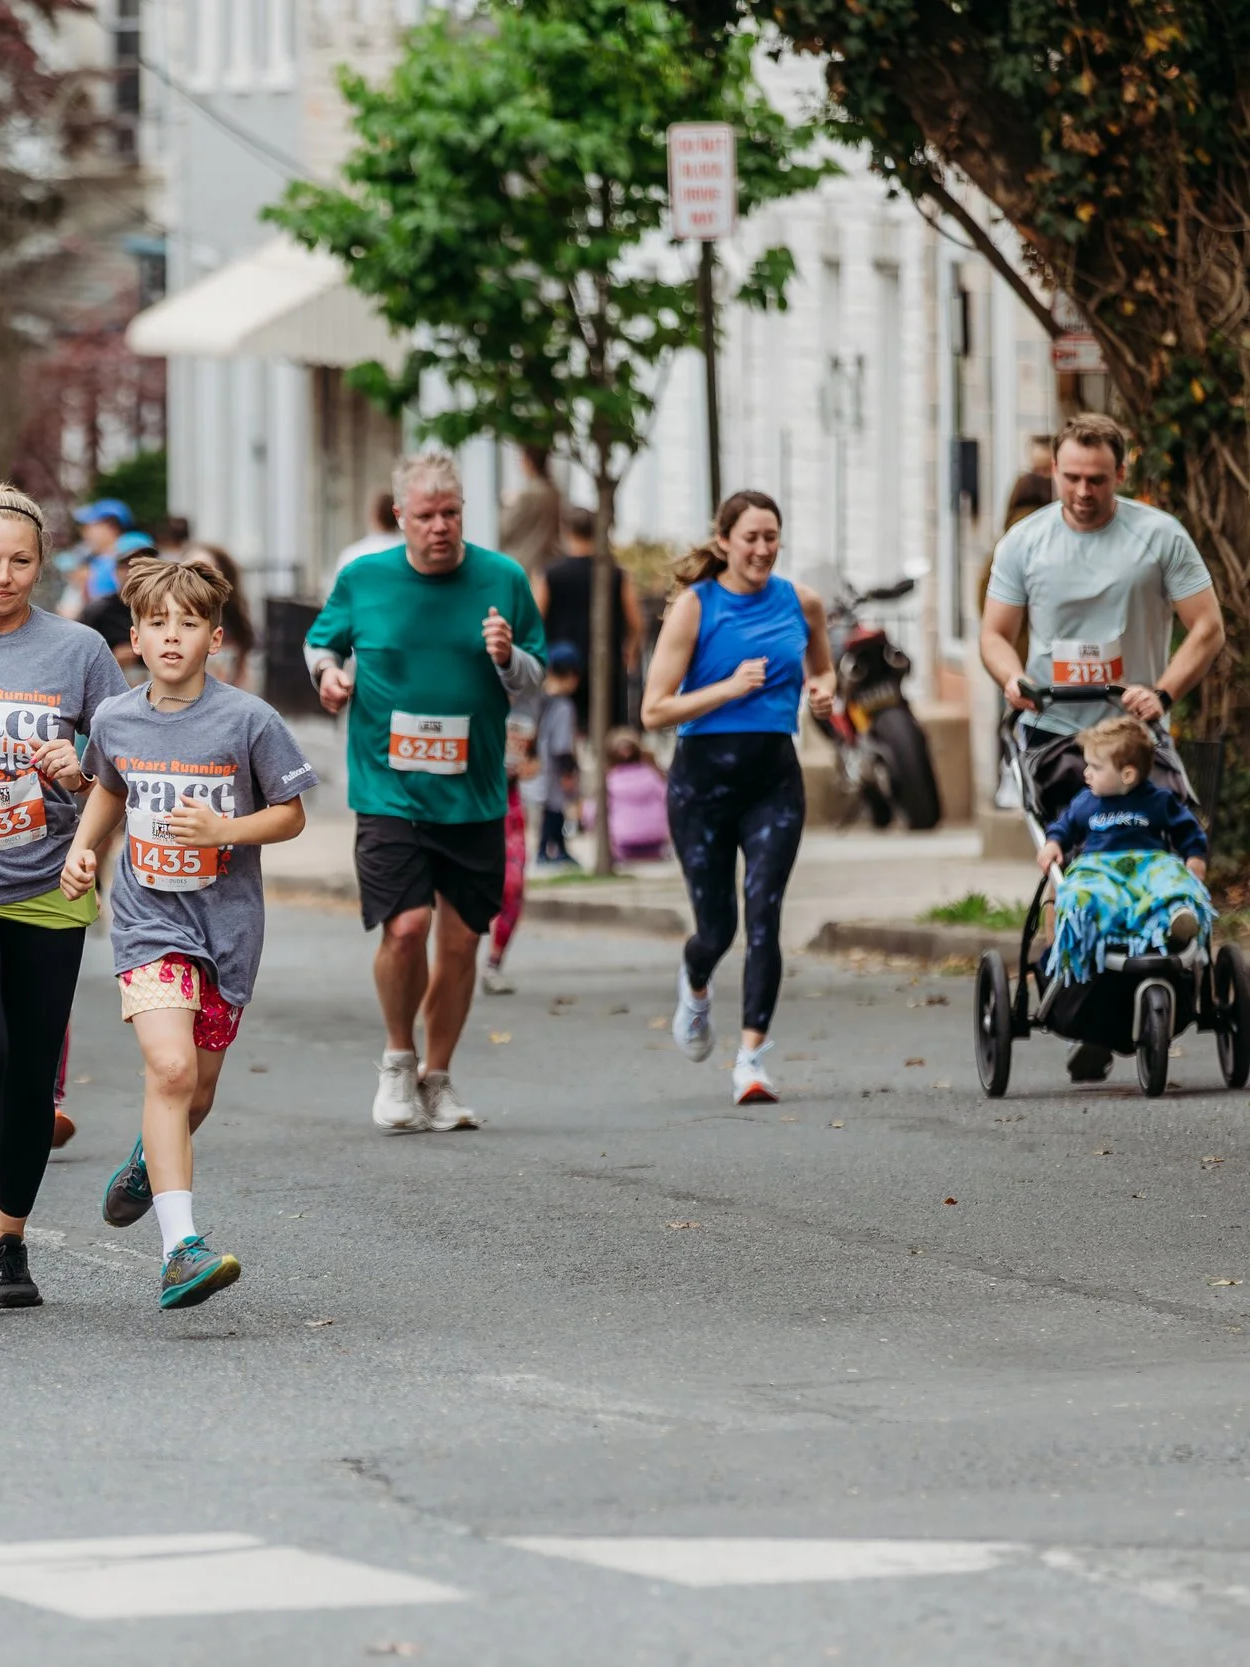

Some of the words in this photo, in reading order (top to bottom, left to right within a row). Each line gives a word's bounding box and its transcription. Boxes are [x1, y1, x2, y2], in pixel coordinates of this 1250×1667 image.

[1067, 663, 1113, 683] 2121
[398, 739, 458, 760] 6245
[130, 758, 166, 772] Years
[136, 842, 201, 874] 1435
